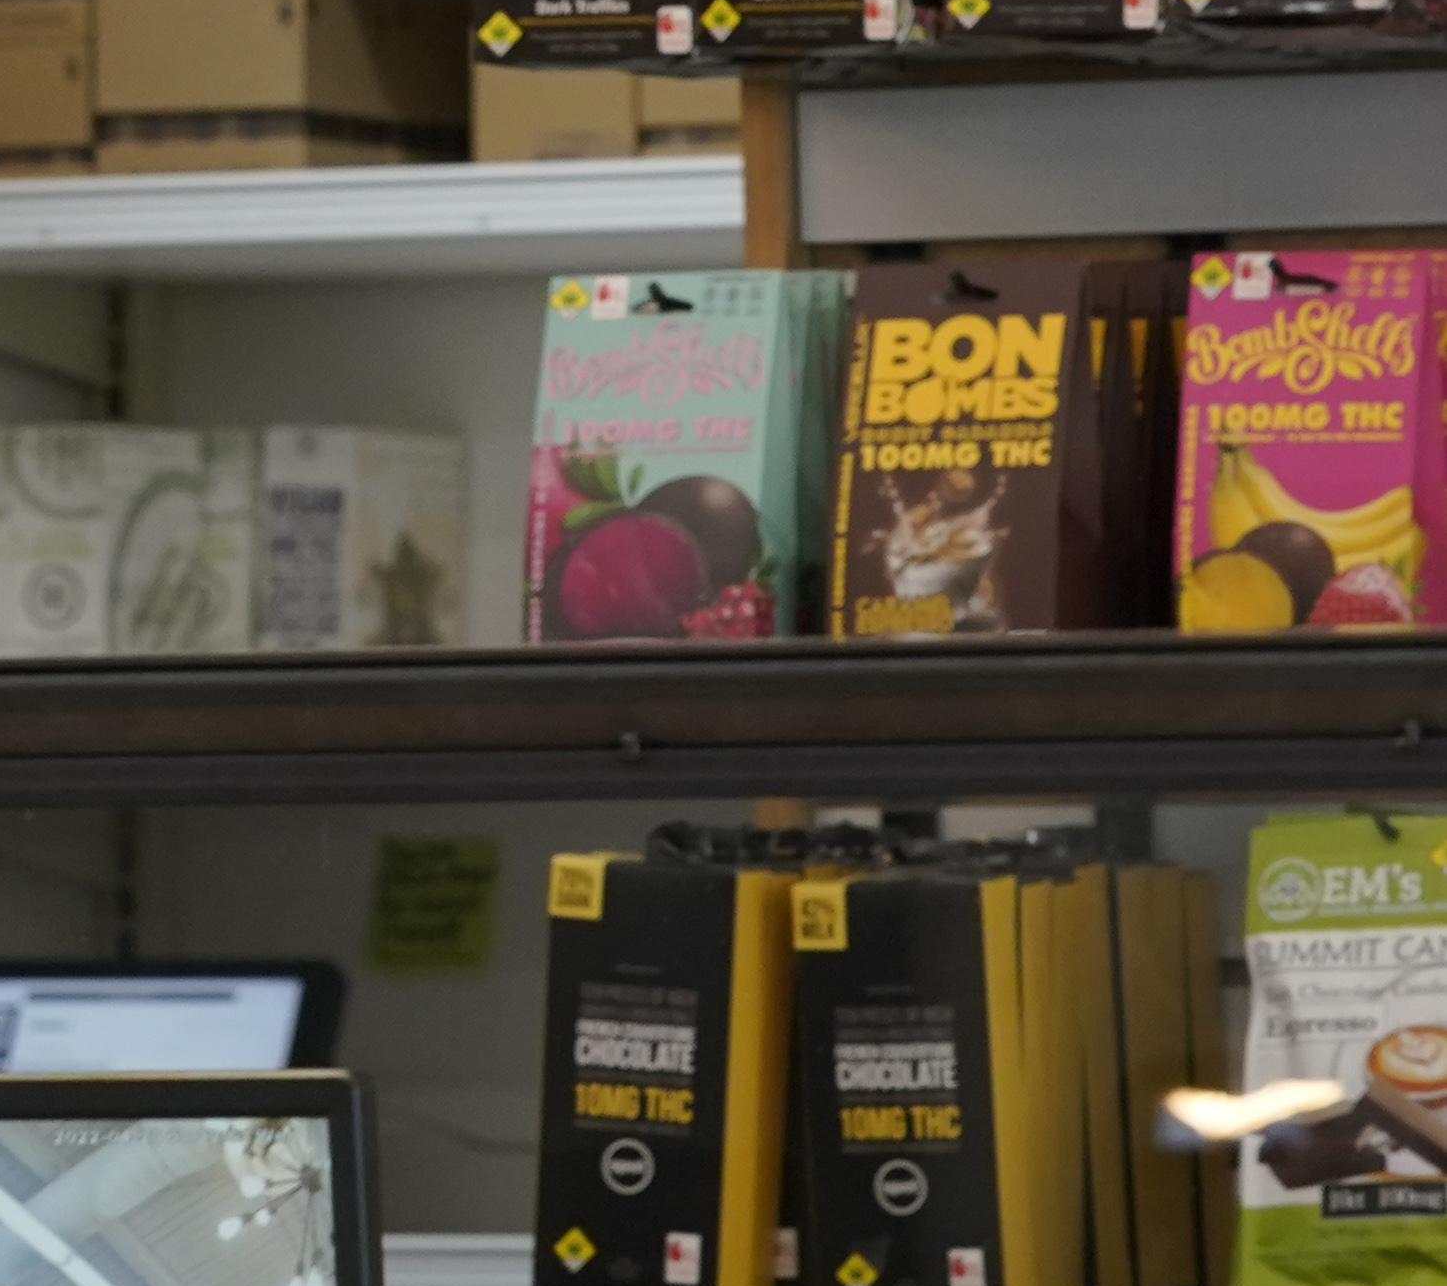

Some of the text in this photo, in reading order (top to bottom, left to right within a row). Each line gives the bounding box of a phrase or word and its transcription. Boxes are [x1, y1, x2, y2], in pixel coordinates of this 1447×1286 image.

[871, 314, 1067, 384] BON
[866, 377, 1059, 425] BOMBS
[1207, 401, 1405, 431] 100MG THC
[562, 415, 752, 445] 100MG THC
[860, 439, 1052, 472] 100MG THC
[1323, 863, 1422, 904] EM's
